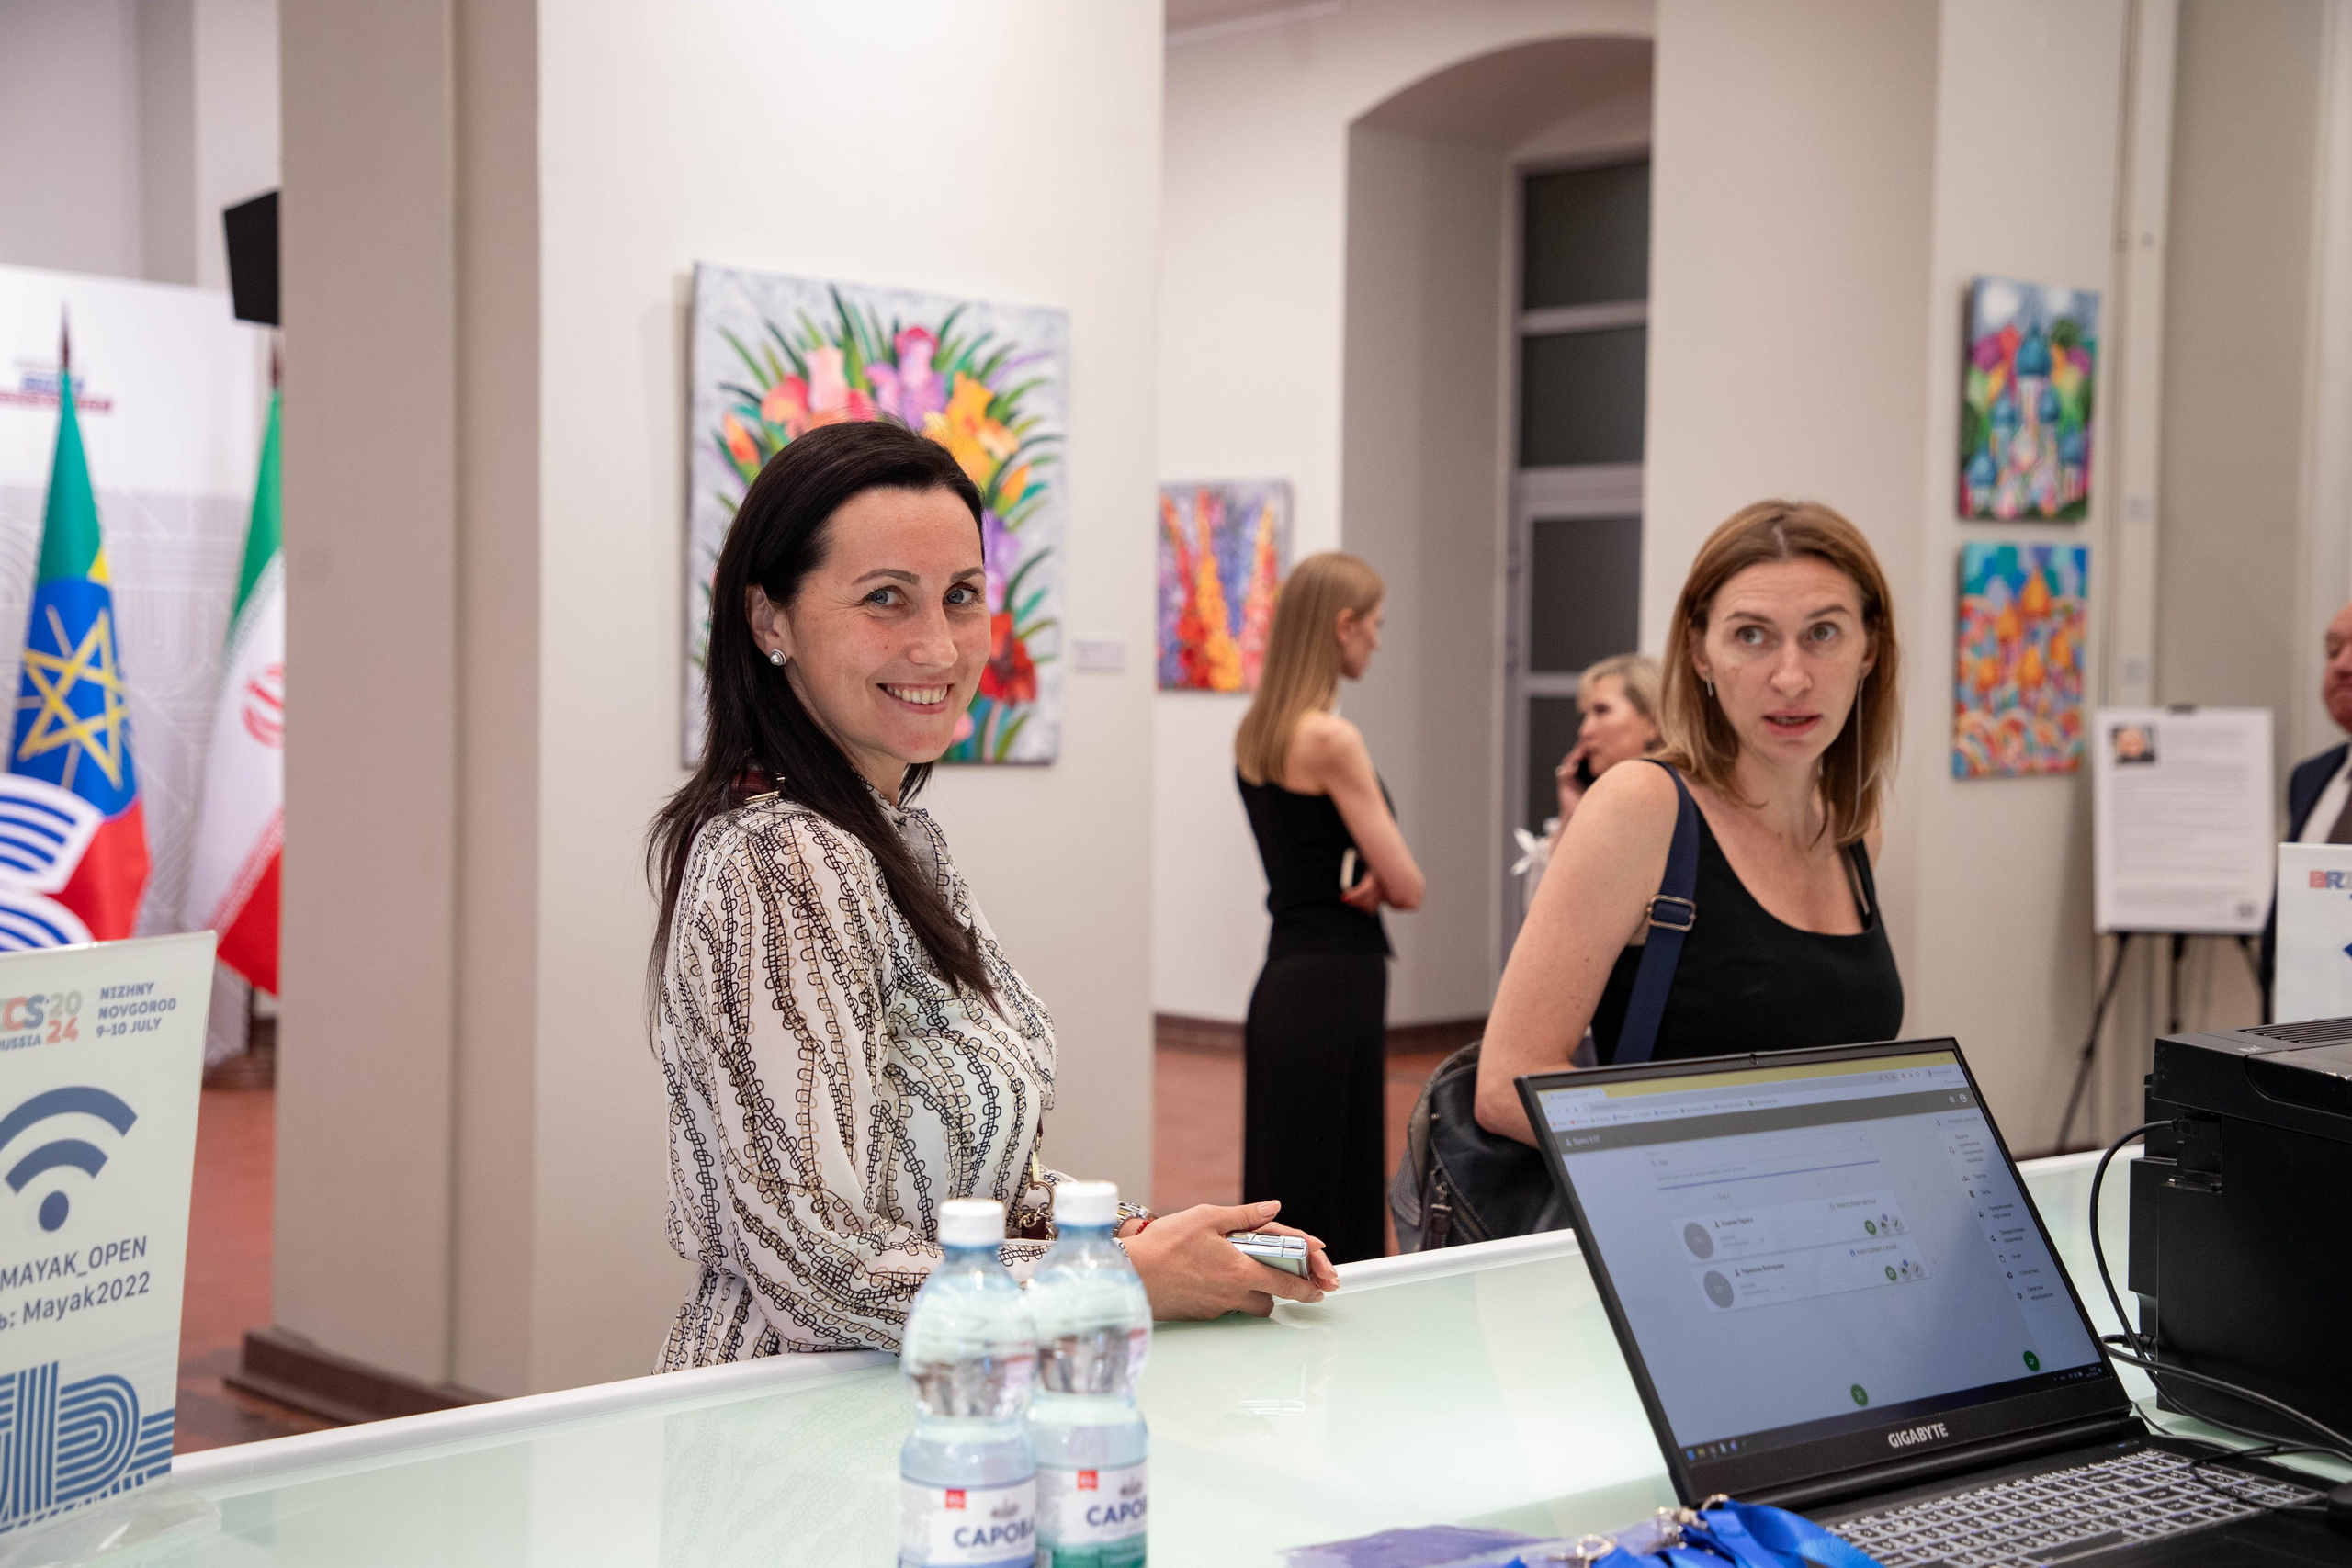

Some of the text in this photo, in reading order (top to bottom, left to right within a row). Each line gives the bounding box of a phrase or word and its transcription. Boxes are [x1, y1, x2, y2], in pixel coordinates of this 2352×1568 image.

[99, 982, 154, 1000] NIZHNY
[48, 990, 83, 1019] 20
[97, 998, 177, 1021] NOVGOROD
[46, 1016, 80, 1045] 24
[130, 1017, 162, 1034] JULY
[0, 1034, 42, 1052] USSIA
[0, 1235, 147, 1292] MAYAK_OPEN
[23, 1271, 150, 1323] Mayak2022
[1888, 1422, 1949, 1448] GIGABYTE
